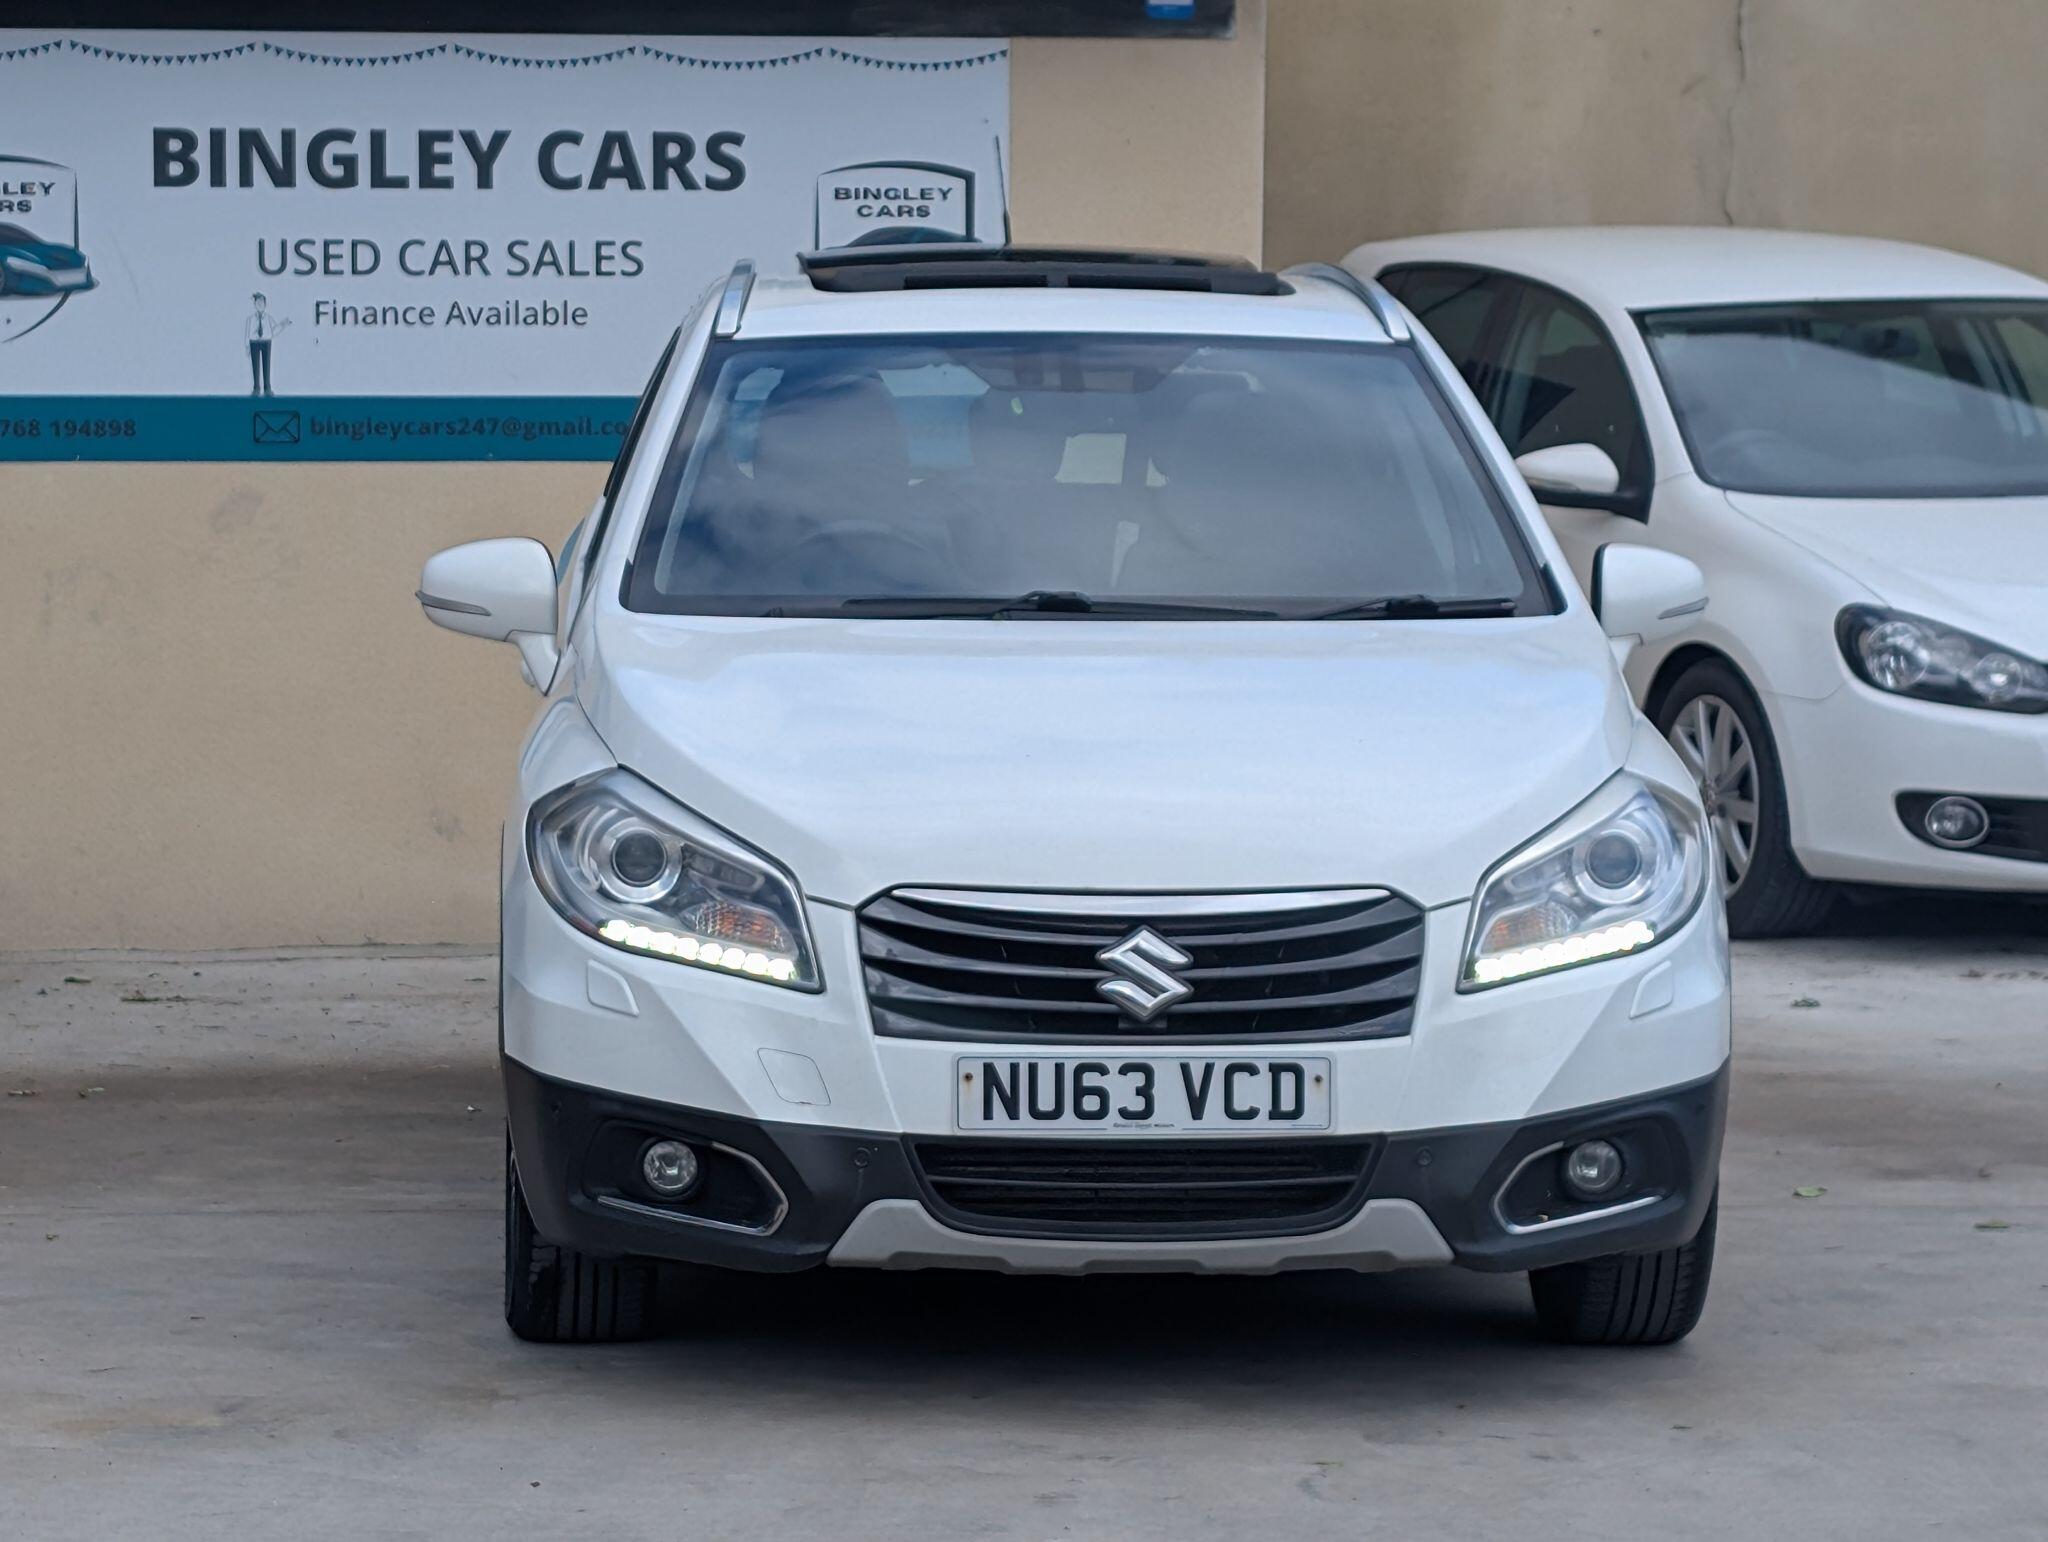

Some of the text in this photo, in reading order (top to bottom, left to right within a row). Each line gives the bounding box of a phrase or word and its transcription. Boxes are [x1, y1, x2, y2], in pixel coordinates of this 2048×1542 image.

[152, 127, 746, 192] BINGLEY CARS
[833, 187, 953, 201] BINGLEY
[856, 204, 931, 218] CARS
[257, 238, 644, 277] USED CAR SALES
[315, 298, 589, 327] Finance Available
[50, 418, 137, 438] 194898
[982, 1061, 1306, 1121] NU63 VCD
